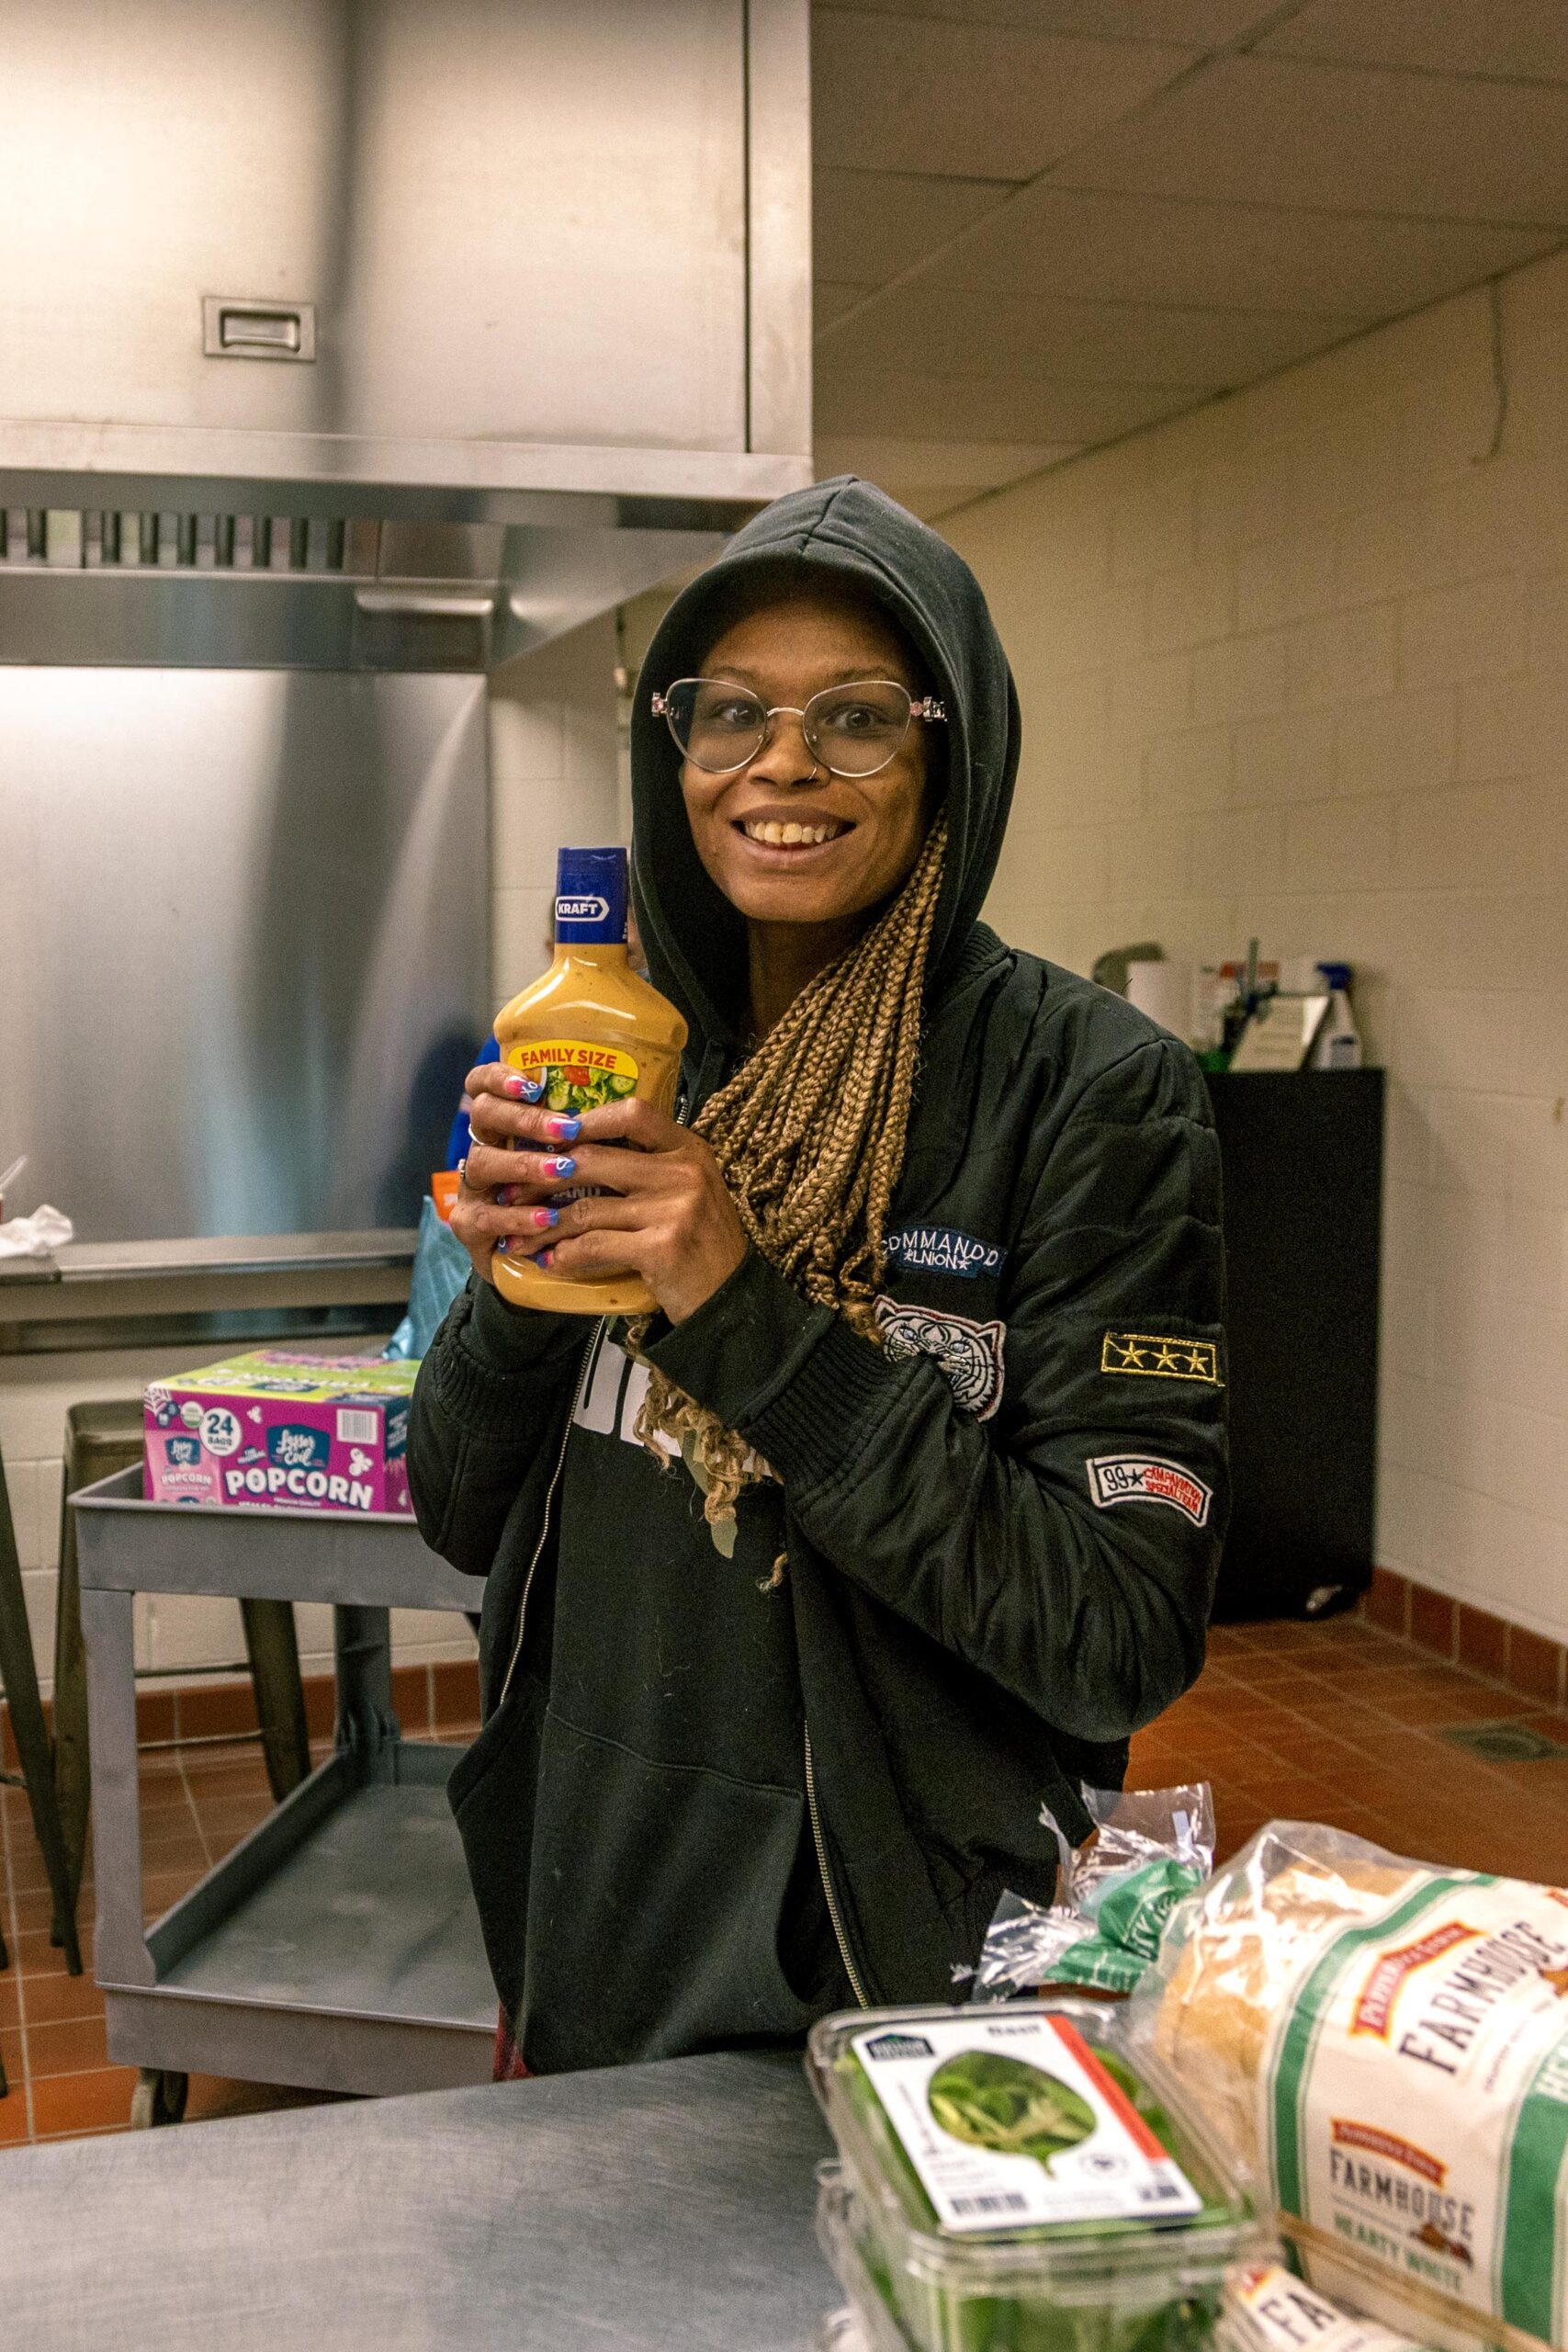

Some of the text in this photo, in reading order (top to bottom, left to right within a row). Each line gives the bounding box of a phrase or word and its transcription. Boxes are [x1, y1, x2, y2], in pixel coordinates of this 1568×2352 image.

[558, 903, 598, 915] KRAFT
[521, 1047, 618, 1069] FAMILY SIZE
[208, 1413, 233, 1435] 24
[208, 1437, 232, 1446] BAGS
[225, 1467, 373, 1510] POPCORN
[1103, 1466, 1129, 1491] 99
[1398, 1921, 1566, 2076] FARMHOUSE
[1330, 2146, 1475, 2241] FARMHOUSE
